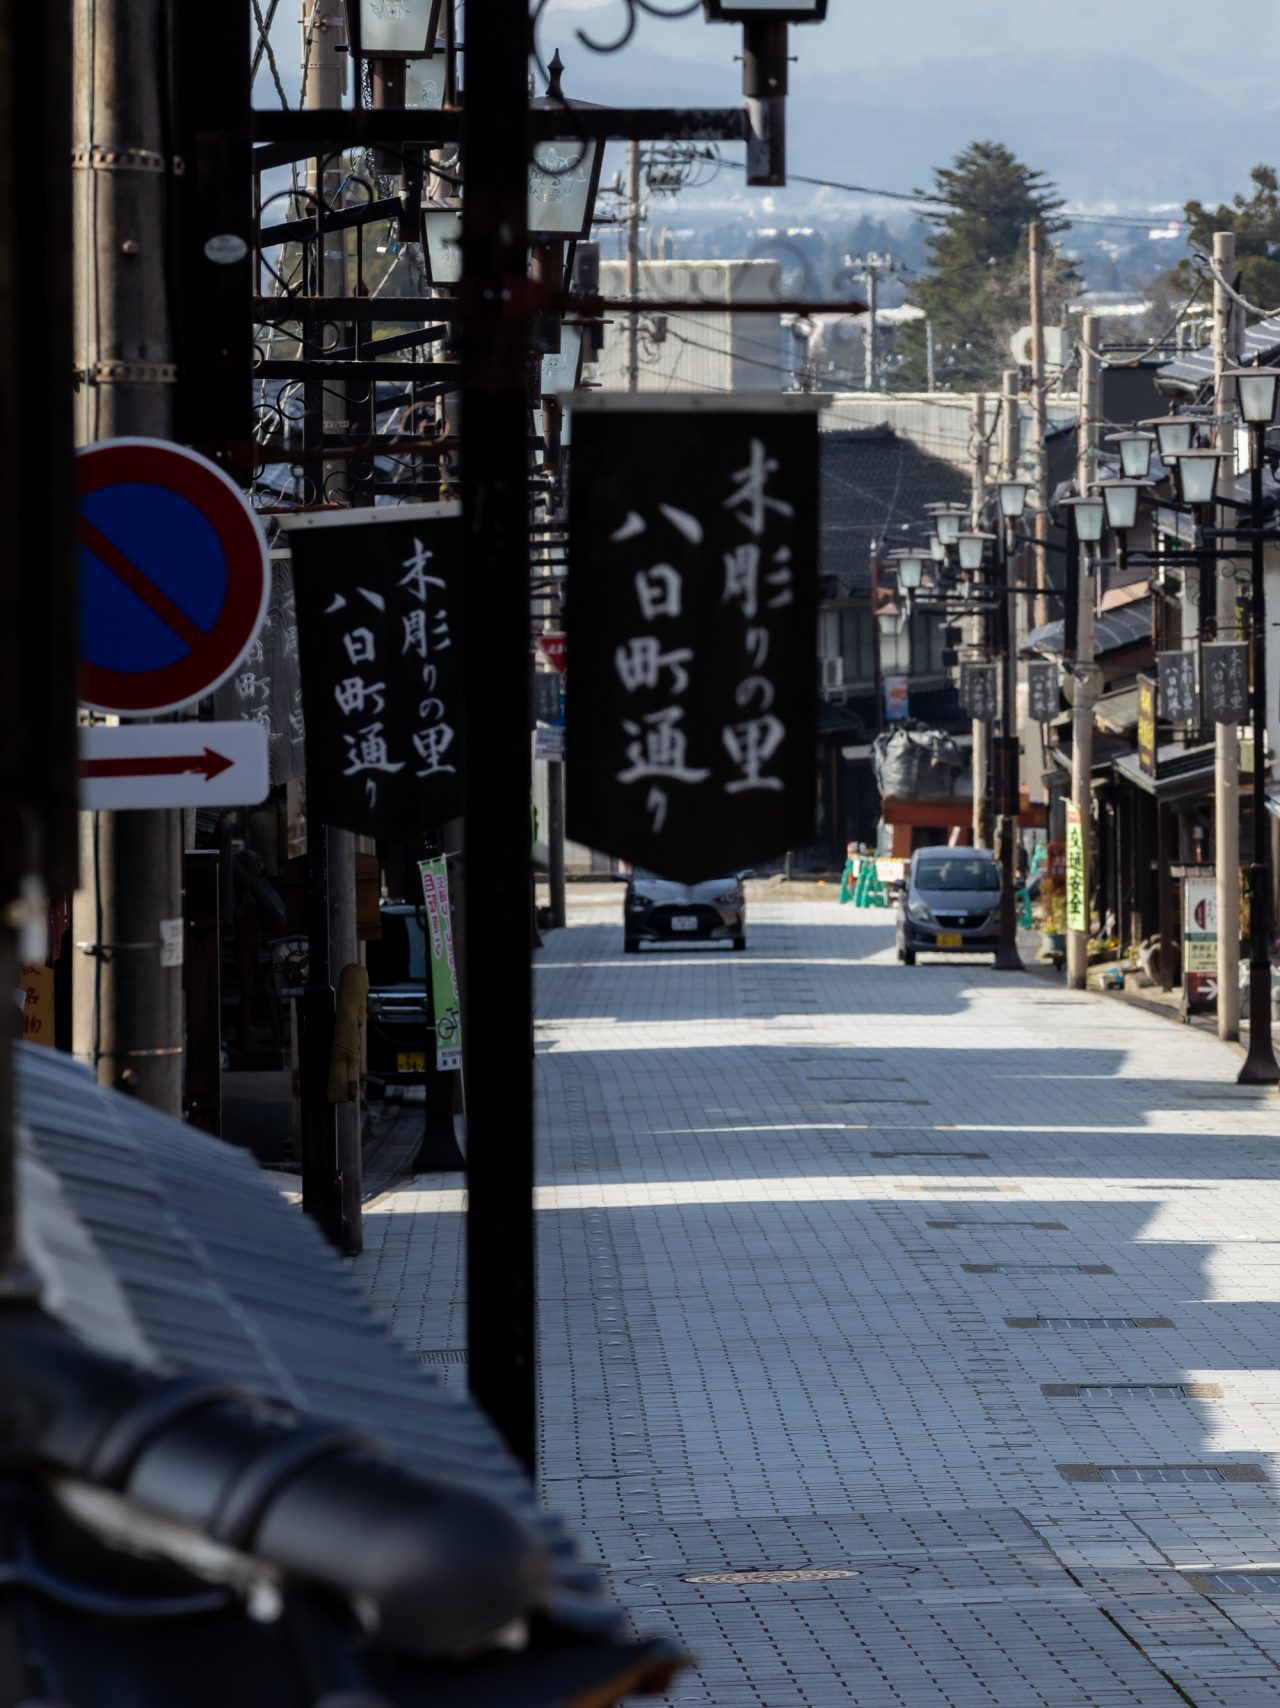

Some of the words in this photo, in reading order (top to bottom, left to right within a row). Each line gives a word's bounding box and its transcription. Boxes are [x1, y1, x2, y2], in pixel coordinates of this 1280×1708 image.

[324, 587, 406, 808] 八日町通り
[397, 537, 457, 777] 木彫りの里
[610, 502, 711, 832] 八日町通り
[722, 438, 794, 794] 木彫りの里
